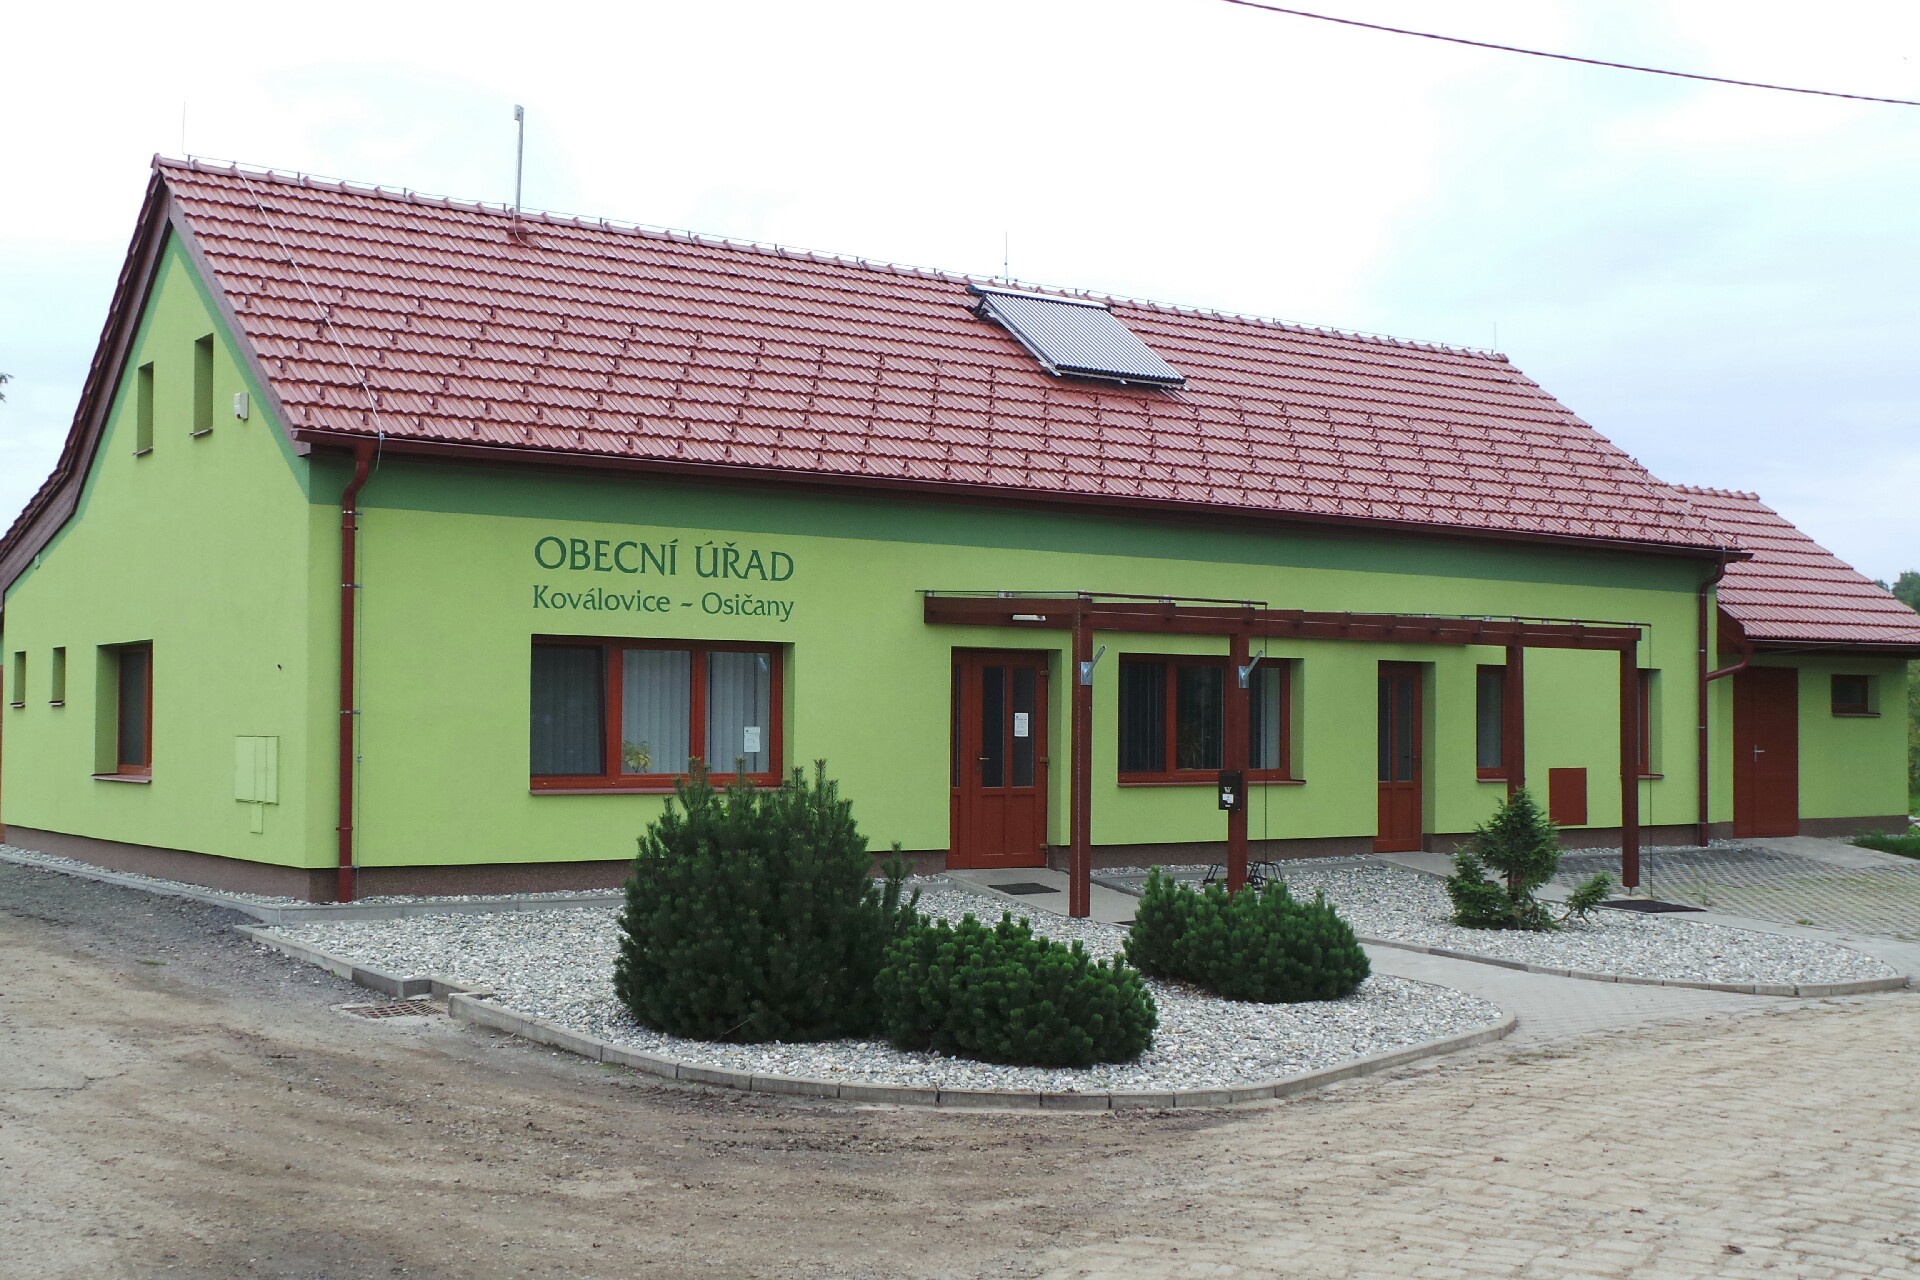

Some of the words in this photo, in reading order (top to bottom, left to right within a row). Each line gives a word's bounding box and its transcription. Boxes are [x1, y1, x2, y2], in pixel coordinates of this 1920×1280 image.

[535, 536, 678, 575] OBECNÍ
[695, 540, 794, 582] ÚŘAD
[532, 585, 670, 612] Koválovice
[702, 592, 794, 622] Osičany
